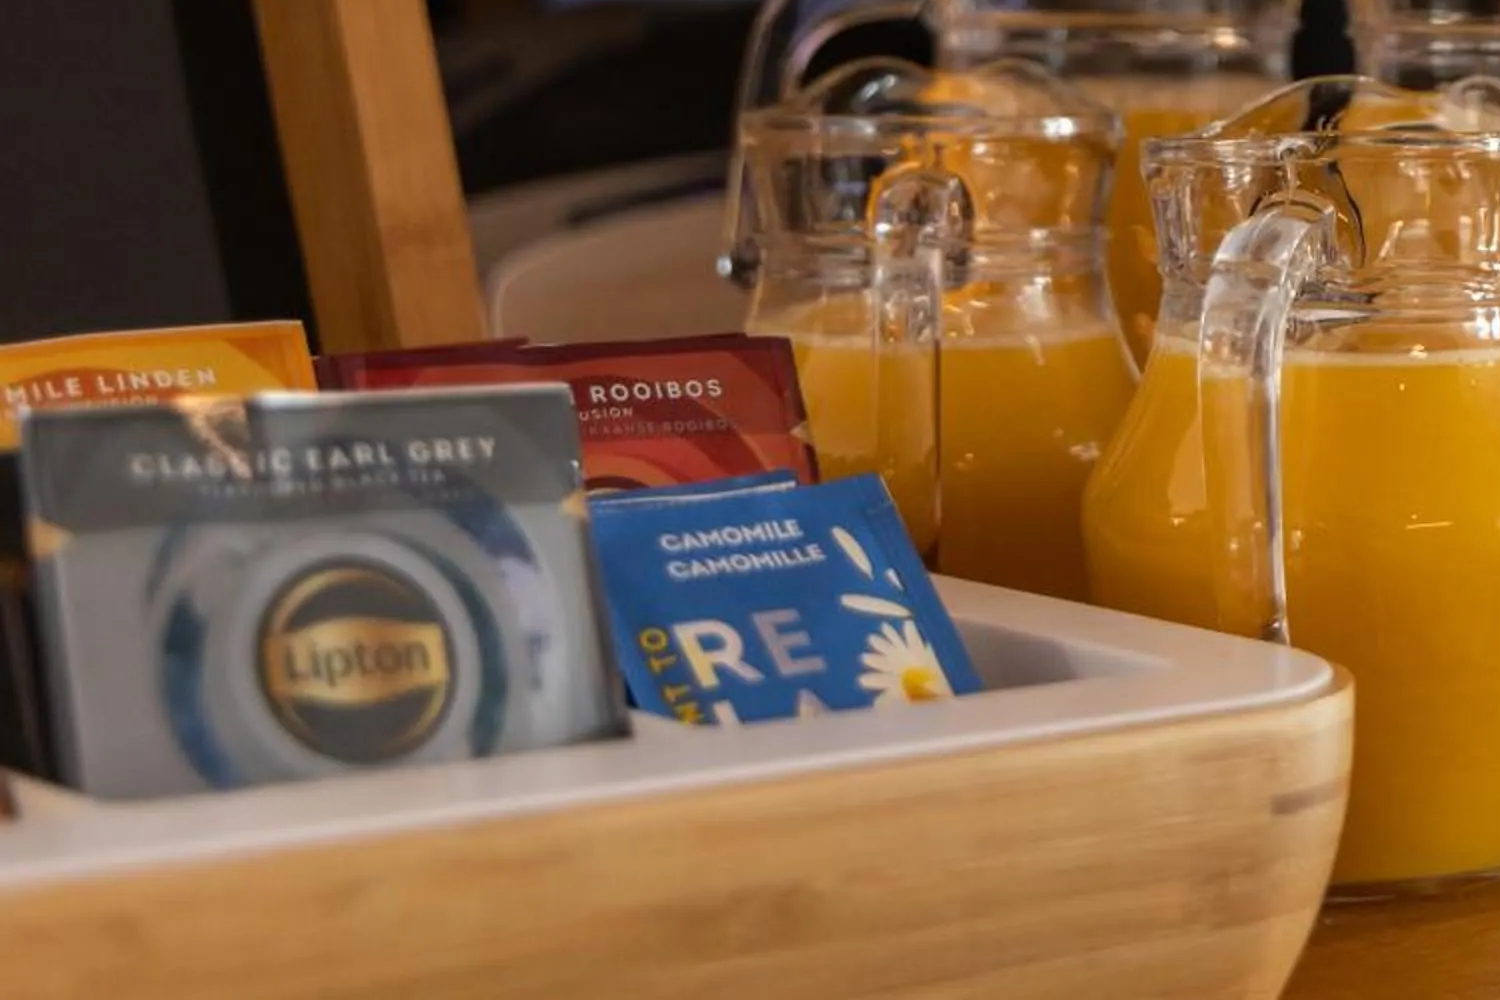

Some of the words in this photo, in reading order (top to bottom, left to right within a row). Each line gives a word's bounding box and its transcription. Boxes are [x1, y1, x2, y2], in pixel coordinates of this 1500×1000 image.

[97, 367, 217, 395] LINDEN
[588, 378, 723, 404] ROOIBOS
[305, 439, 396, 470] EARL
[407, 433, 496, 464] GREY
[658, 518, 804, 553] CAMOMILE
[666, 542, 827, 580] CAMOMILLE
[285, 638, 430, 688] Lipton
